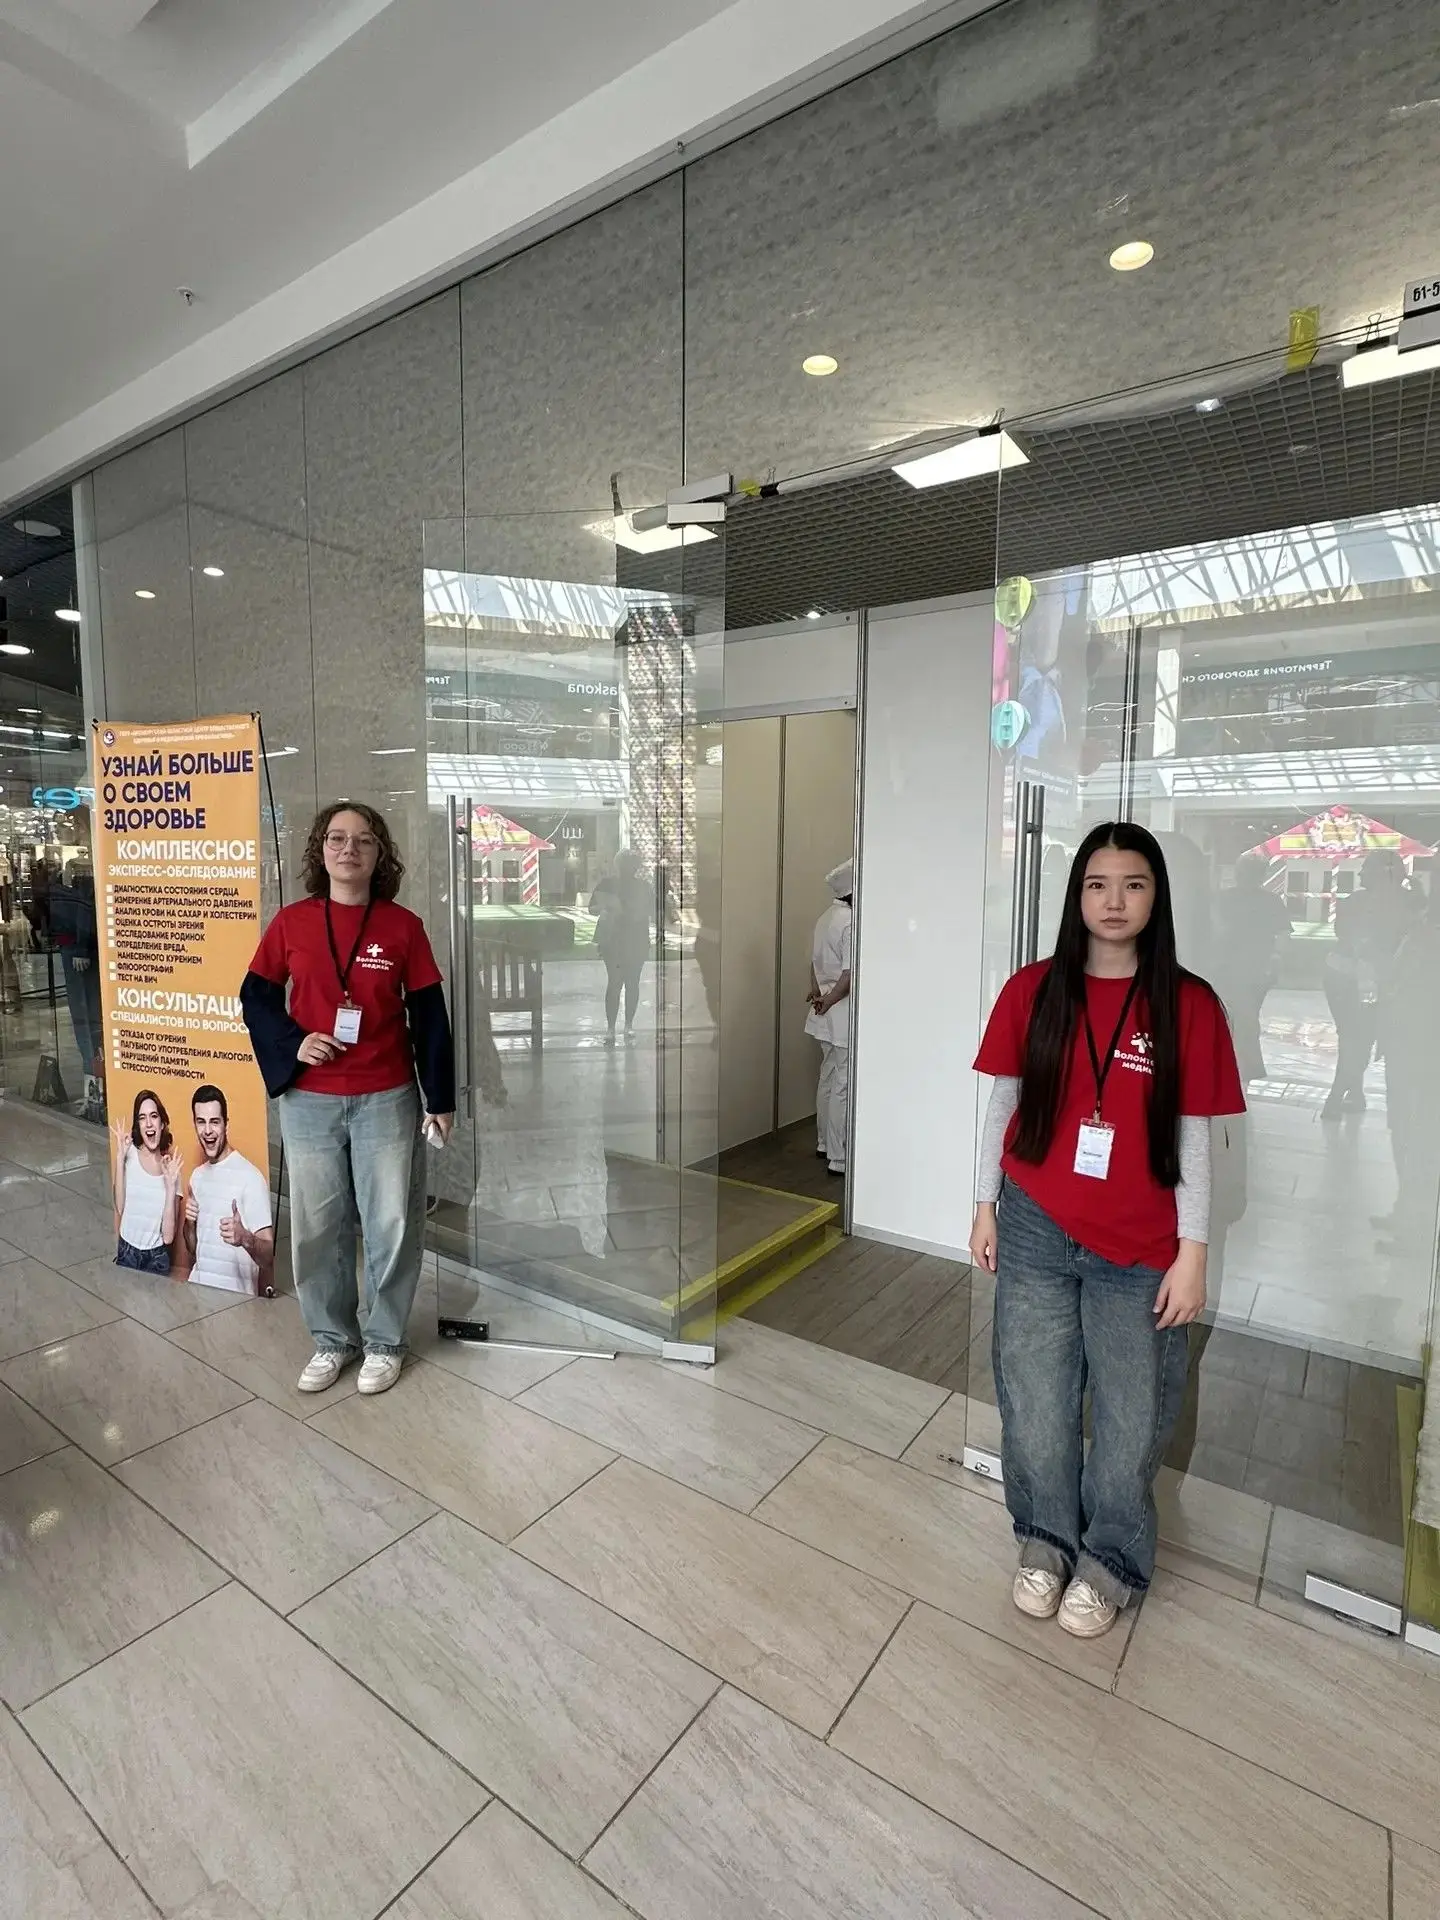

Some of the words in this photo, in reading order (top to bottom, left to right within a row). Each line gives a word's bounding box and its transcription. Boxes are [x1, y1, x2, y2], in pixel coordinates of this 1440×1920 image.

[102, 750, 162, 777] УЗНАЙ
[168, 750, 254, 776] БОЛЬШЕ
[103, 783, 117, 804] О
[122, 781, 190, 803] СВОЕМ
[104, 808, 206, 833] ЗДОРОВЬЕ
[117, 840, 256, 861] КОМПЛЕКСНОЕ
[108, 864, 257, 880] ЭКСПРЕСС-ОБСЛЕДОВАНИЕ
[114, 885, 162, 895] ДИАГНОСТИКА
[164, 886, 208, 895] СОСТОЯНИЯ
[210, 887, 238, 897] СЕРДЦА
[115, 896, 151, 905] ИЗМЕРЕНИЕ
[153, 897, 212, 907] АРТЕРИАЛЬНОГО
[213, 899, 253, 909] ДАВЛЕНИЯ
[115, 908, 141, 916] АНАЛИЗ
[142, 909, 165, 917] КРОВИ
[178, 910, 201, 918] САХАР
[203, 911, 208, 919] И
[210, 911, 257, 920] ХОЛЕСТЕРИН
[116, 919, 141, 928] ОЦЕНКА
[143, 920, 176, 928] ОСТРОТЫ
[178, 921, 204, 930] ЗРЕНИЯ
[116, 930, 169, 940] ИССЛЕДОВАНИЕ
[170, 932, 205, 941] РОДИНОК
[117, 941, 162, 950] ОПРЕДЕЛЕНИЕ
[118, 952, 164, 962] НАНЕСЕННОГО
[166, 954, 202, 964] КУРЕНИЕМ
[117, 963, 173, 974] ФЛЮОРОГРАФИЯ
[118, 974, 132, 982] ТЕСТ
[144, 976, 157, 984] ВИЧ
[117, 988, 243, 1020] КОНСУЛЬТАЦИ
[111, 1011, 184, 1028] СПЕЦИАЛИСТОВ
[186, 1018, 200, 1028] ПО
[203, 1020, 250, 1034] ВОПРОС
[120, 1029, 144, 1039] ОТКАЗА
[146, 1032, 154, 1040] ОТ
[156, 1034, 186, 1043] КУРЕНИЯ
[121, 1040, 156, 1052] ПАГУБНОГО
[159, 1045, 211, 1058] УПОТРЕБЛЕНИЯ
[213, 1051, 253, 1062] АЛКОГОЛЯ
[121, 1051, 159, 1063] НАРУШЕНИЙ
[161, 1056, 189, 1066] ПАМЯТИ
[122, 1061, 205, 1080] СТРЕССОУСТОЙЧИВОСТИ
